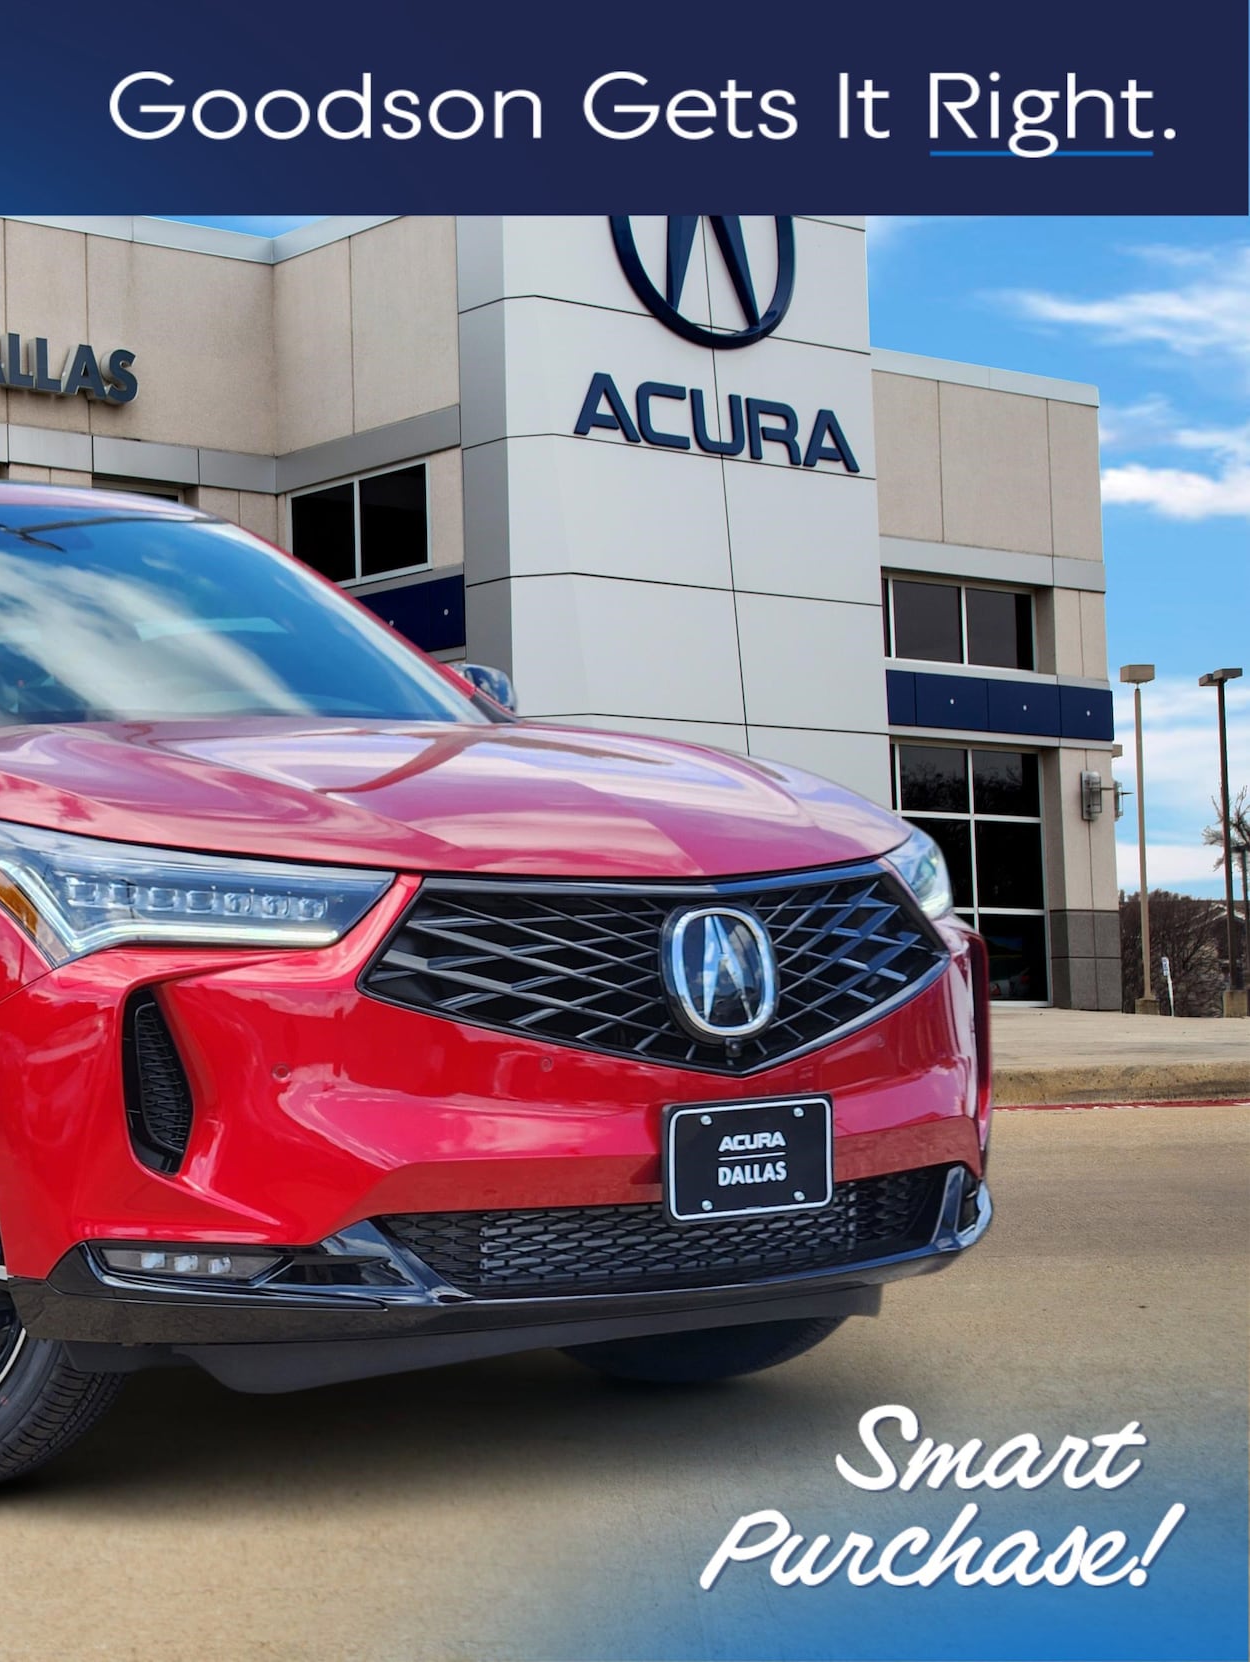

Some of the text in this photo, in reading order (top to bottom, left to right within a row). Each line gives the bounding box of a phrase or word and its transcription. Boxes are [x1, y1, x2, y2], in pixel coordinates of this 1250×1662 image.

[573, 371, 861, 474] ACURA
[717, 1131, 787, 1152] ACURA
[717, 1161, 787, 1187] DALLAS
